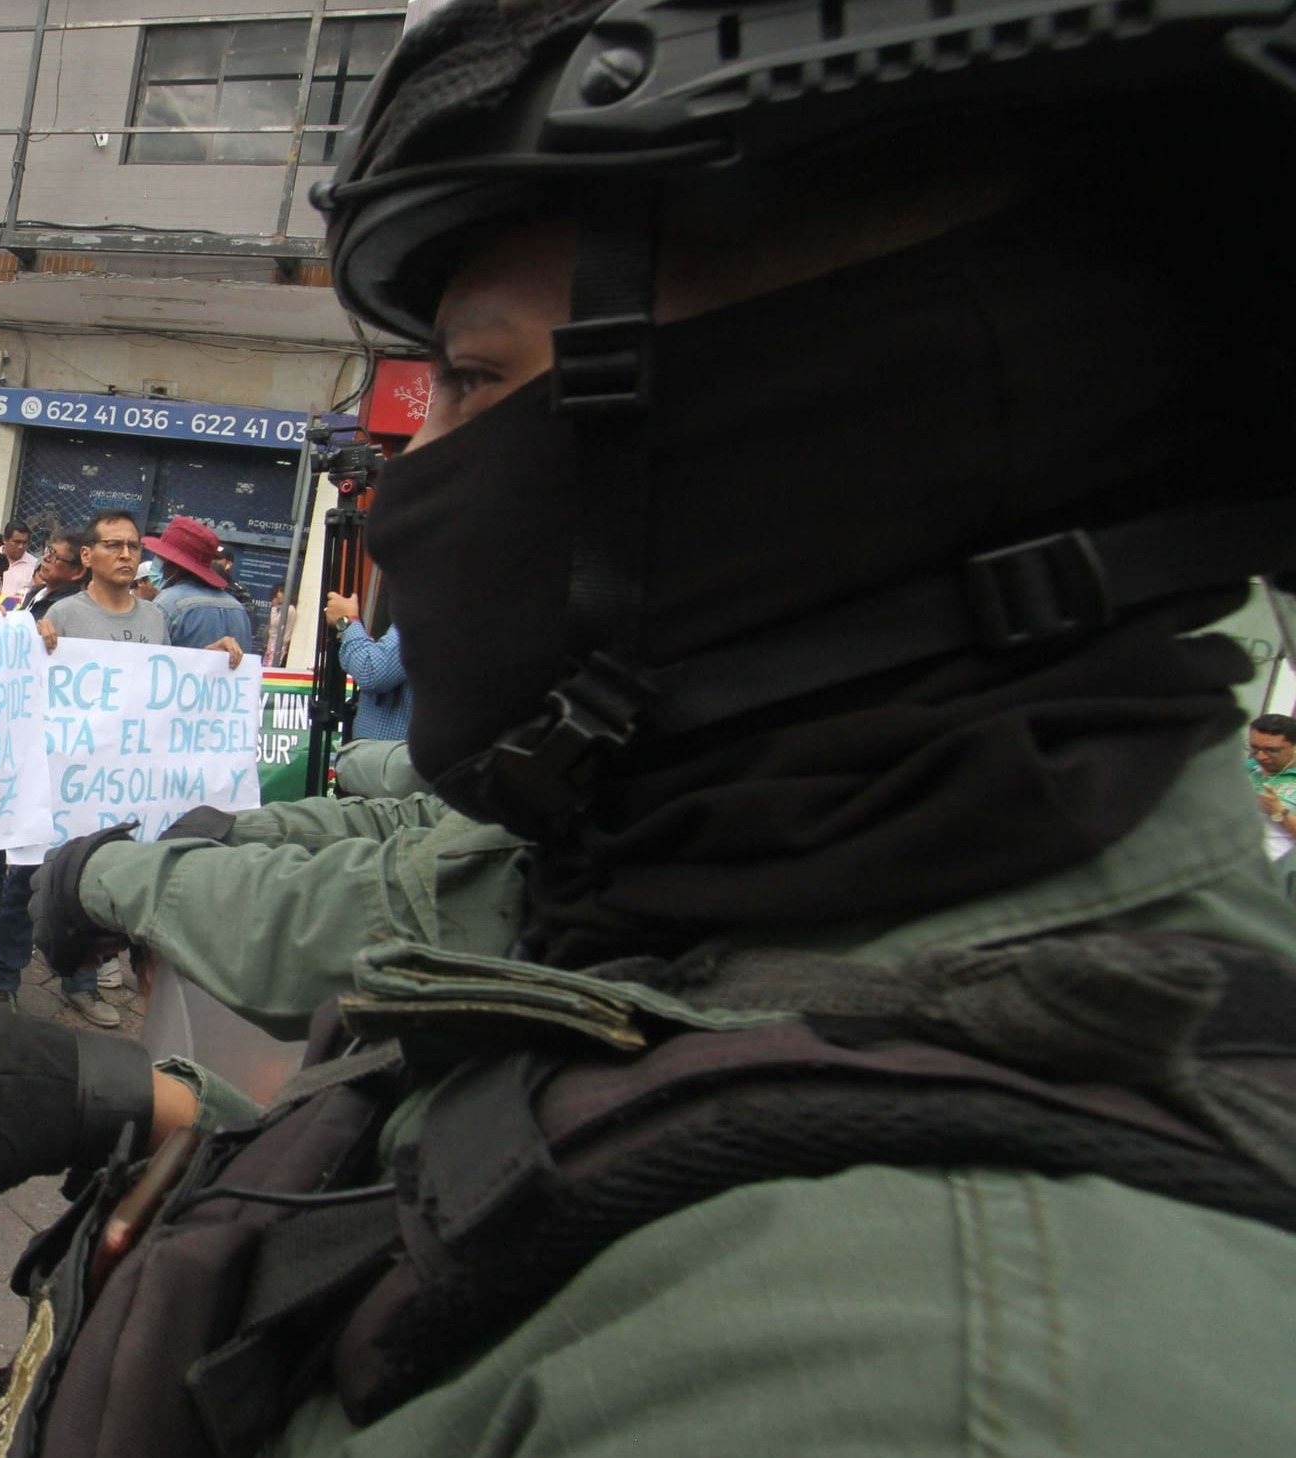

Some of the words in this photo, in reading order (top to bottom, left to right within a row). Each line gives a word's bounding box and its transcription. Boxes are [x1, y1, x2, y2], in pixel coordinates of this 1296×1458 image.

[46, 401, 87, 423] 622
[94, 406, 115, 425] 41
[124, 408, 169, 430] 036
[191, 413, 236, 437] 622
[243, 418, 267, 439] 41
[276, 420, 306, 443] 03
[48, 662, 123, 711] RCE
[119, 718, 151, 755] EL
[168, 717, 254, 753] DIESEL
[60, 764, 205, 805] GASOLINA
[229, 768, 249, 804] Y
